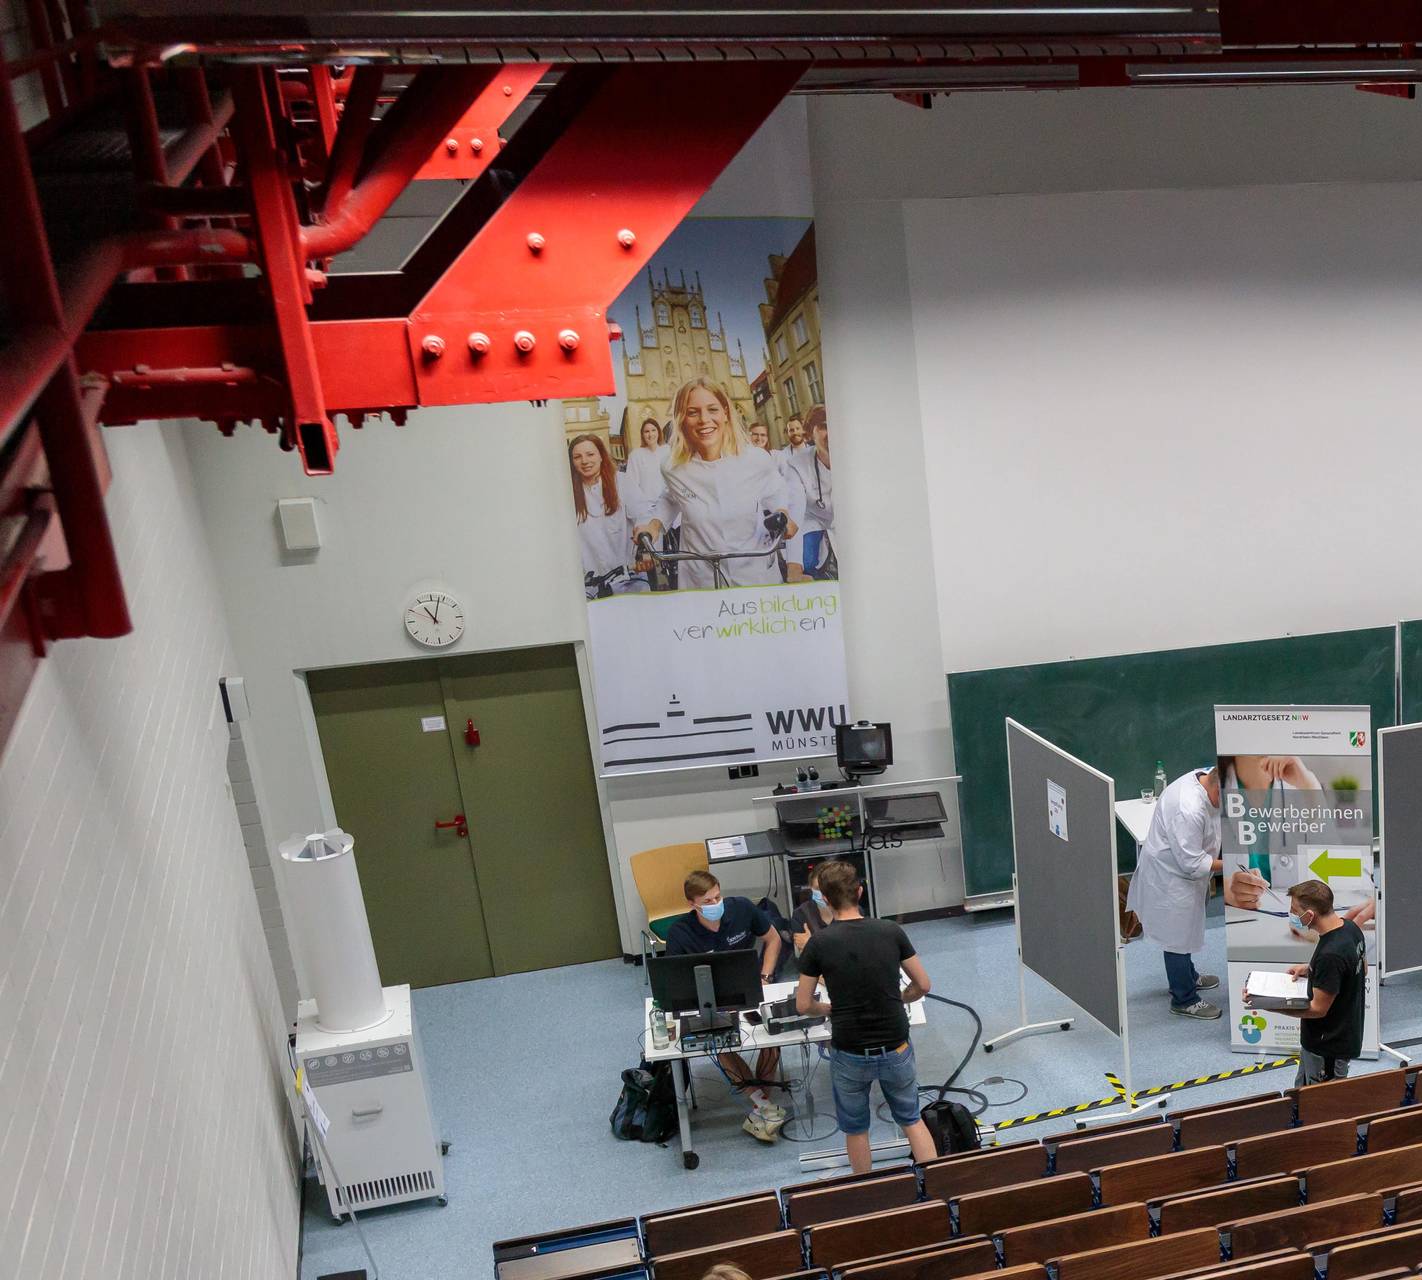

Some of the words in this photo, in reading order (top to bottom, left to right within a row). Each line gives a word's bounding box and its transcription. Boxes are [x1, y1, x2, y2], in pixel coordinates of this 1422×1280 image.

[718, 592, 837, 618] Ausbildung
[765, 704, 847, 735] WWU
[772, 736, 836, 751] MÜNSTE
[1226, 793, 1364, 819] Bewerberinnen
[1238, 819, 1327, 846] Bewerber
